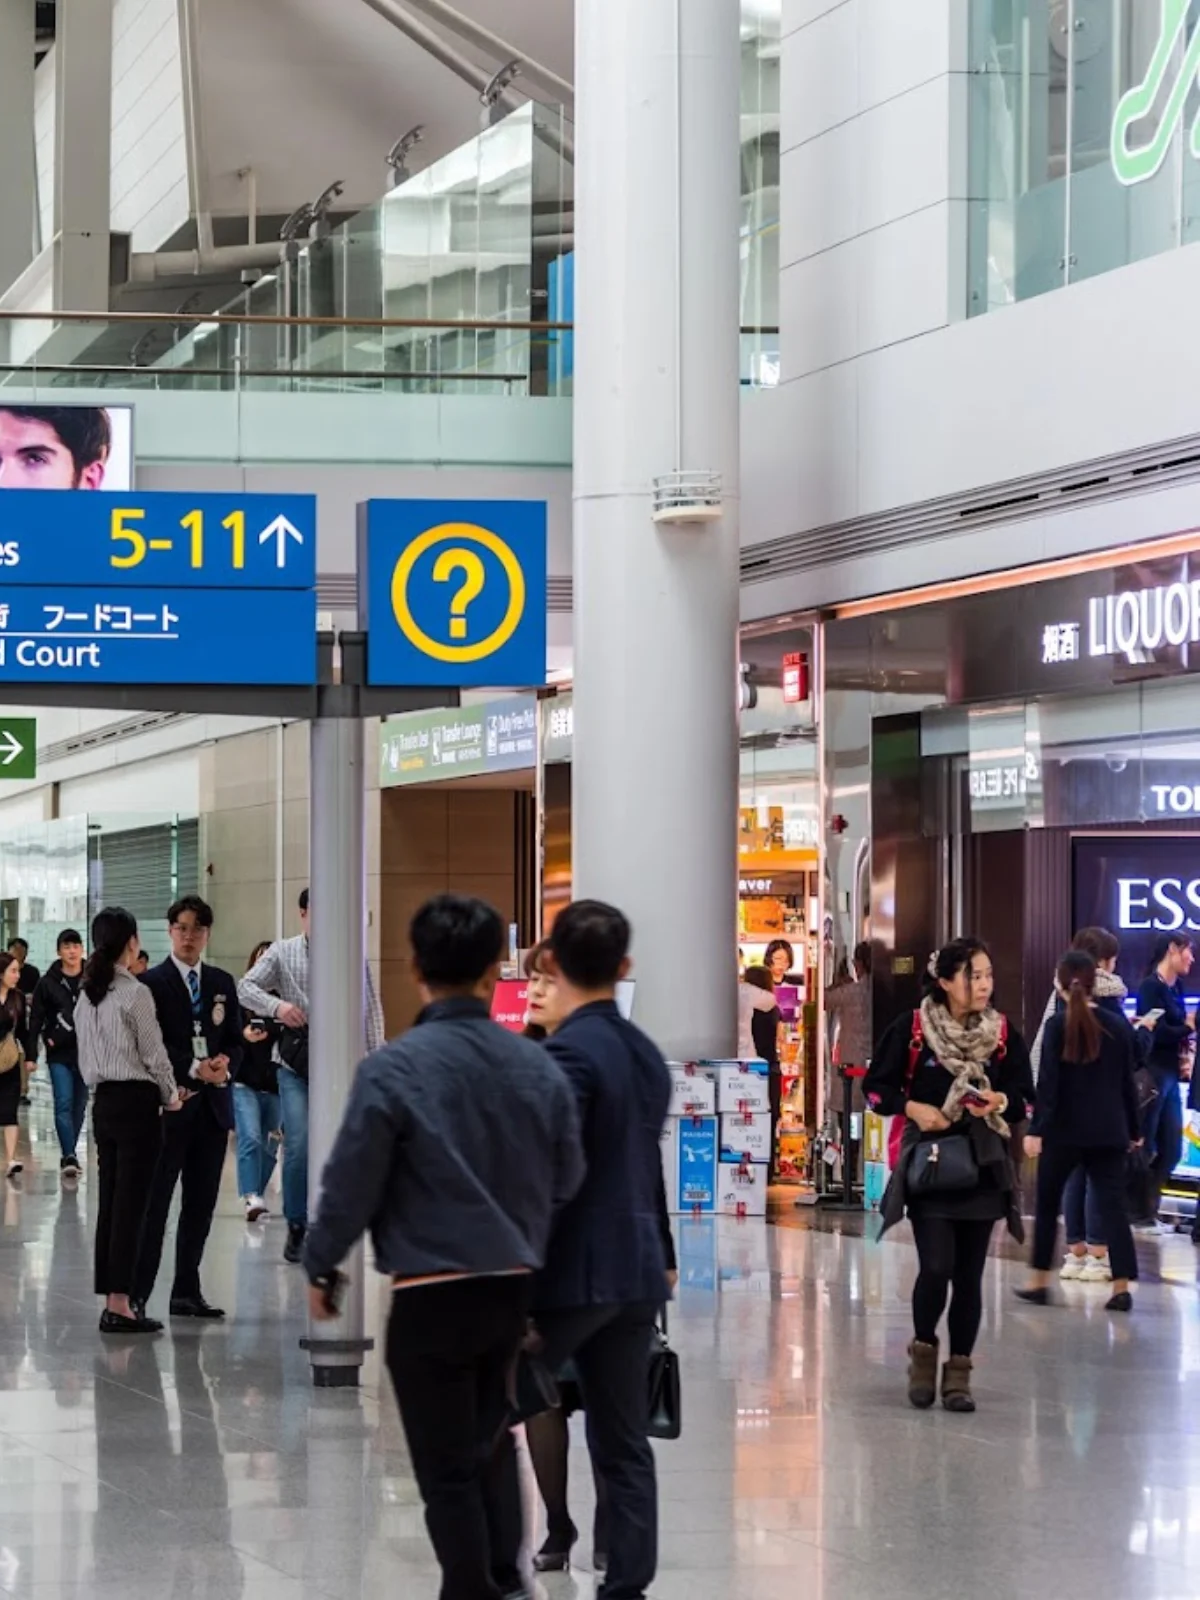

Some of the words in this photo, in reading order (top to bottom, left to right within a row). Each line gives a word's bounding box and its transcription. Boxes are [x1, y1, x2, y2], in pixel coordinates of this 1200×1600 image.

[110, 508, 245, 569] 5-11
[43, 604, 179, 632] フードコート
[16, 641, 101, 668] Court
